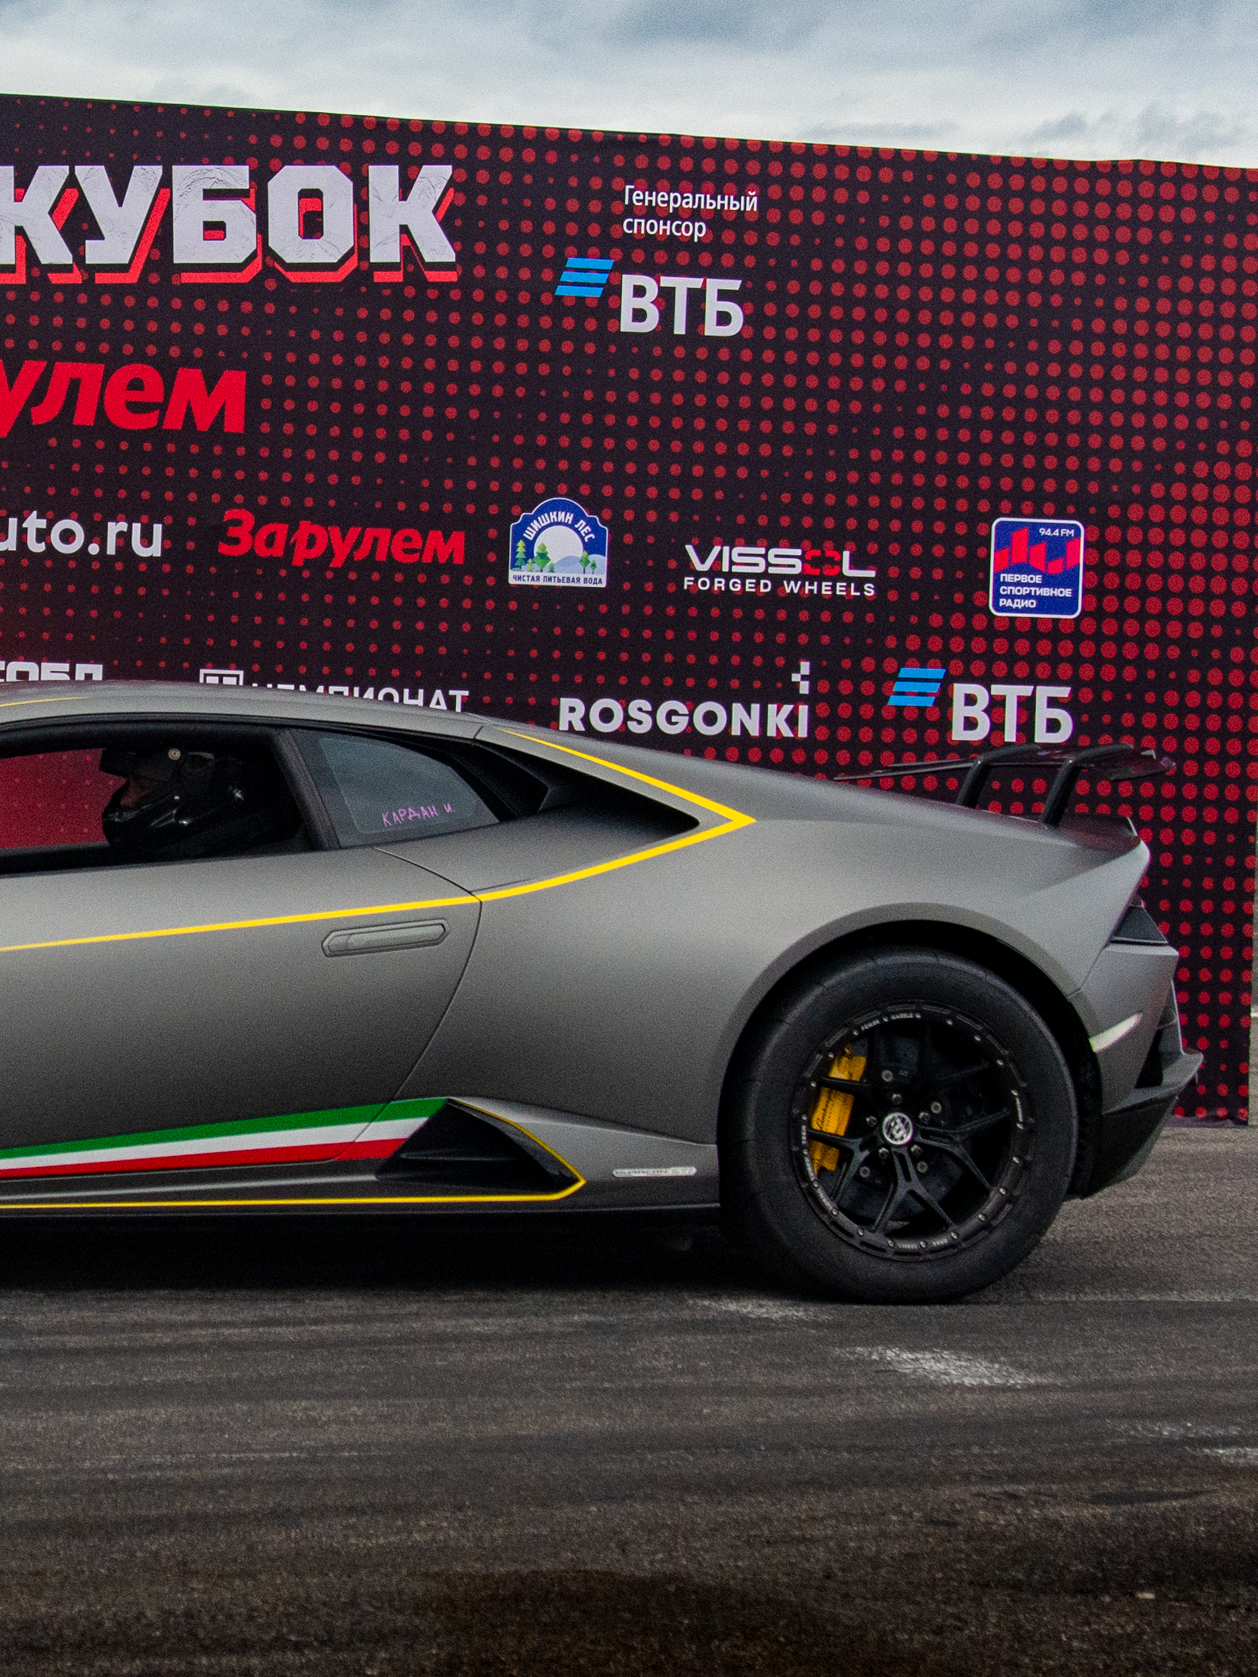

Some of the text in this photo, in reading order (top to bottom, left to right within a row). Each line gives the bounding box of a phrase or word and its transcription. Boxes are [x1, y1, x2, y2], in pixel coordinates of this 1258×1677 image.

[624, 184, 758, 214] Генеральный
[622, 217, 707, 243] спонсор
[620, 273, 744, 337] ВТБ
[523, 511, 595, 542] ШИШКИН ЛЕС
[1039, 528, 1074, 537] 94.4 FM
[684, 544, 876, 578] VISSOL
[512, 574, 603, 586] ЧИСТАЯ ПИТЬЕВАЯ ВОДА
[683, 576, 876, 597] FORGED WHEELS
[999, 573, 1043, 584] ПЕРВОЕ
[999, 585, 1073, 597] СПОРТИВНОЕ
[999, 598, 1037, 609] РАДИО
[252, 683, 470, 713] ИОНАТ
[558, 697, 809, 738] ROSGONKI
[951, 682, 1074, 744] ВТБ
[381, 804, 440, 828] КАРДАН
